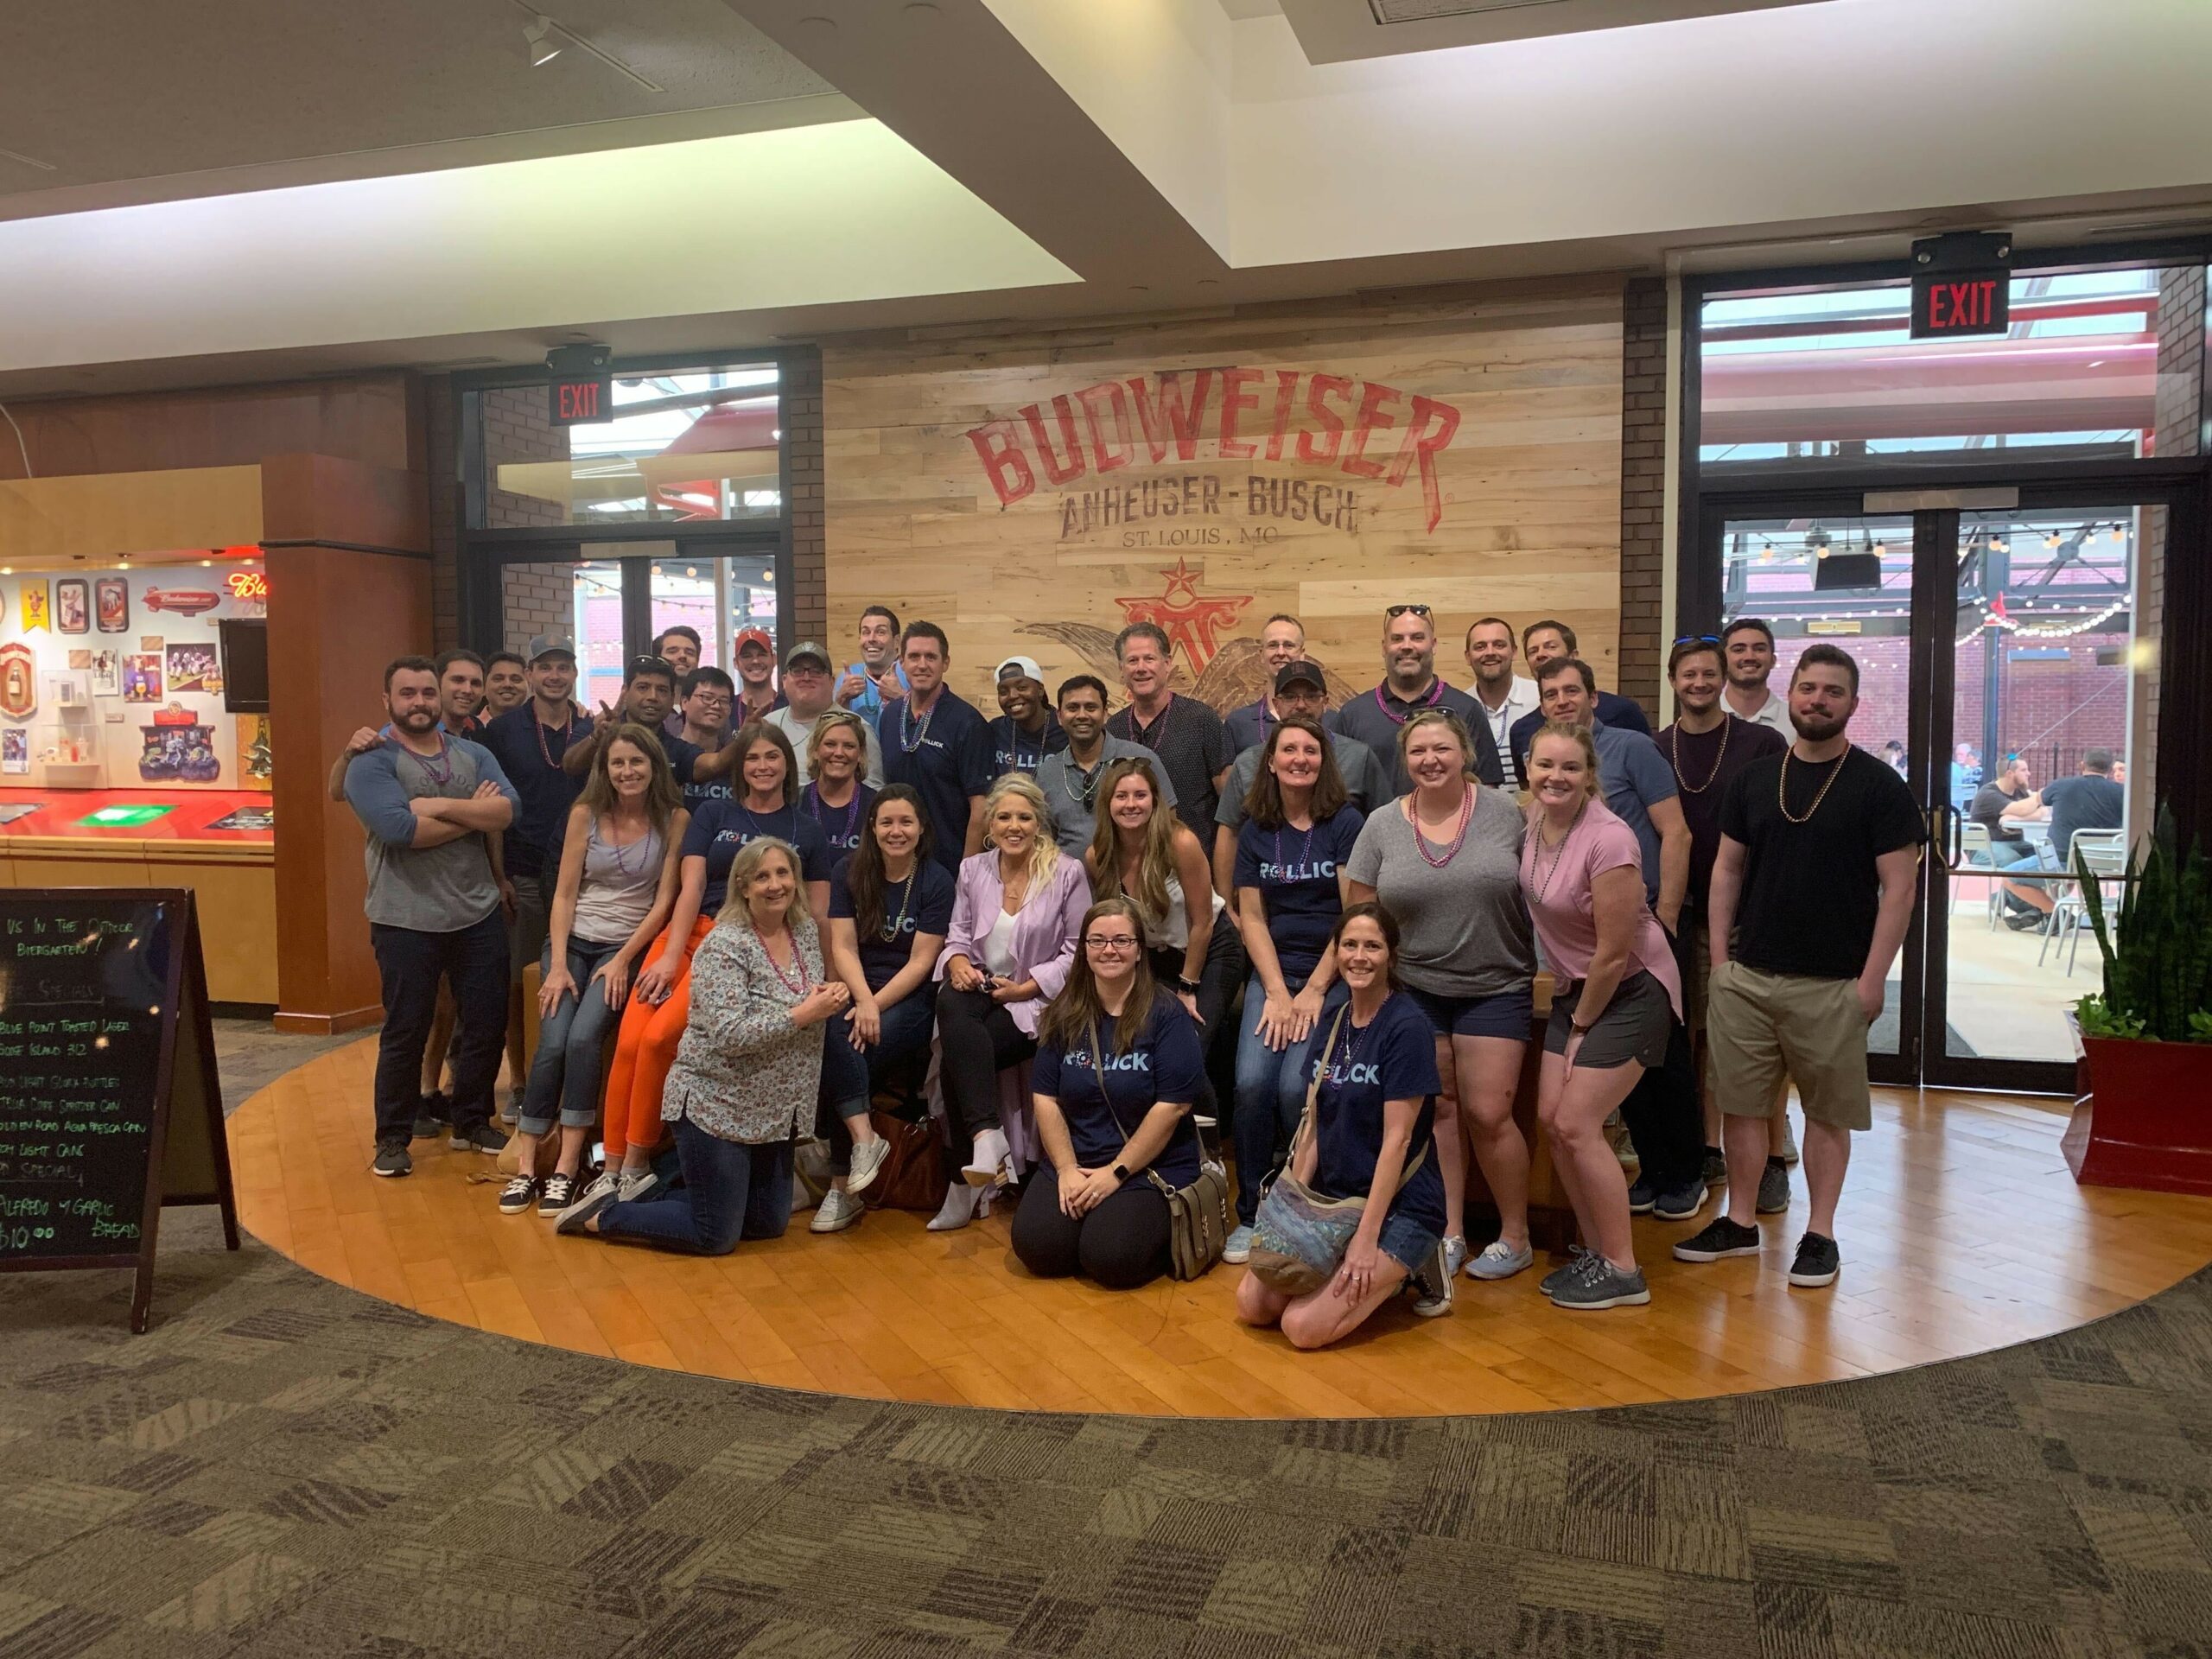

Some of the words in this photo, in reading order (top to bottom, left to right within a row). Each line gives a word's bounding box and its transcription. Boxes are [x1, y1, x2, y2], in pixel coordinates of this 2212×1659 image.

[1929, 280, 1996, 328] EXIT
[559, 383, 599, 418] EXIT
[966, 367, 1461, 534] BUDWEISER
[1122, 531, 1153, 547] ST.
[1239, 526, 1279, 544] MO
[228, 573, 266, 598] Bu
[922, 738, 944, 748] OLLICK
[995, 750, 1056, 767] ROLL
[684, 782, 734, 799] LLICK
[1259, 860, 1337, 880] ROLLIC
[55, 918, 78, 933] THE
[67, 1043, 87, 1056] 312
